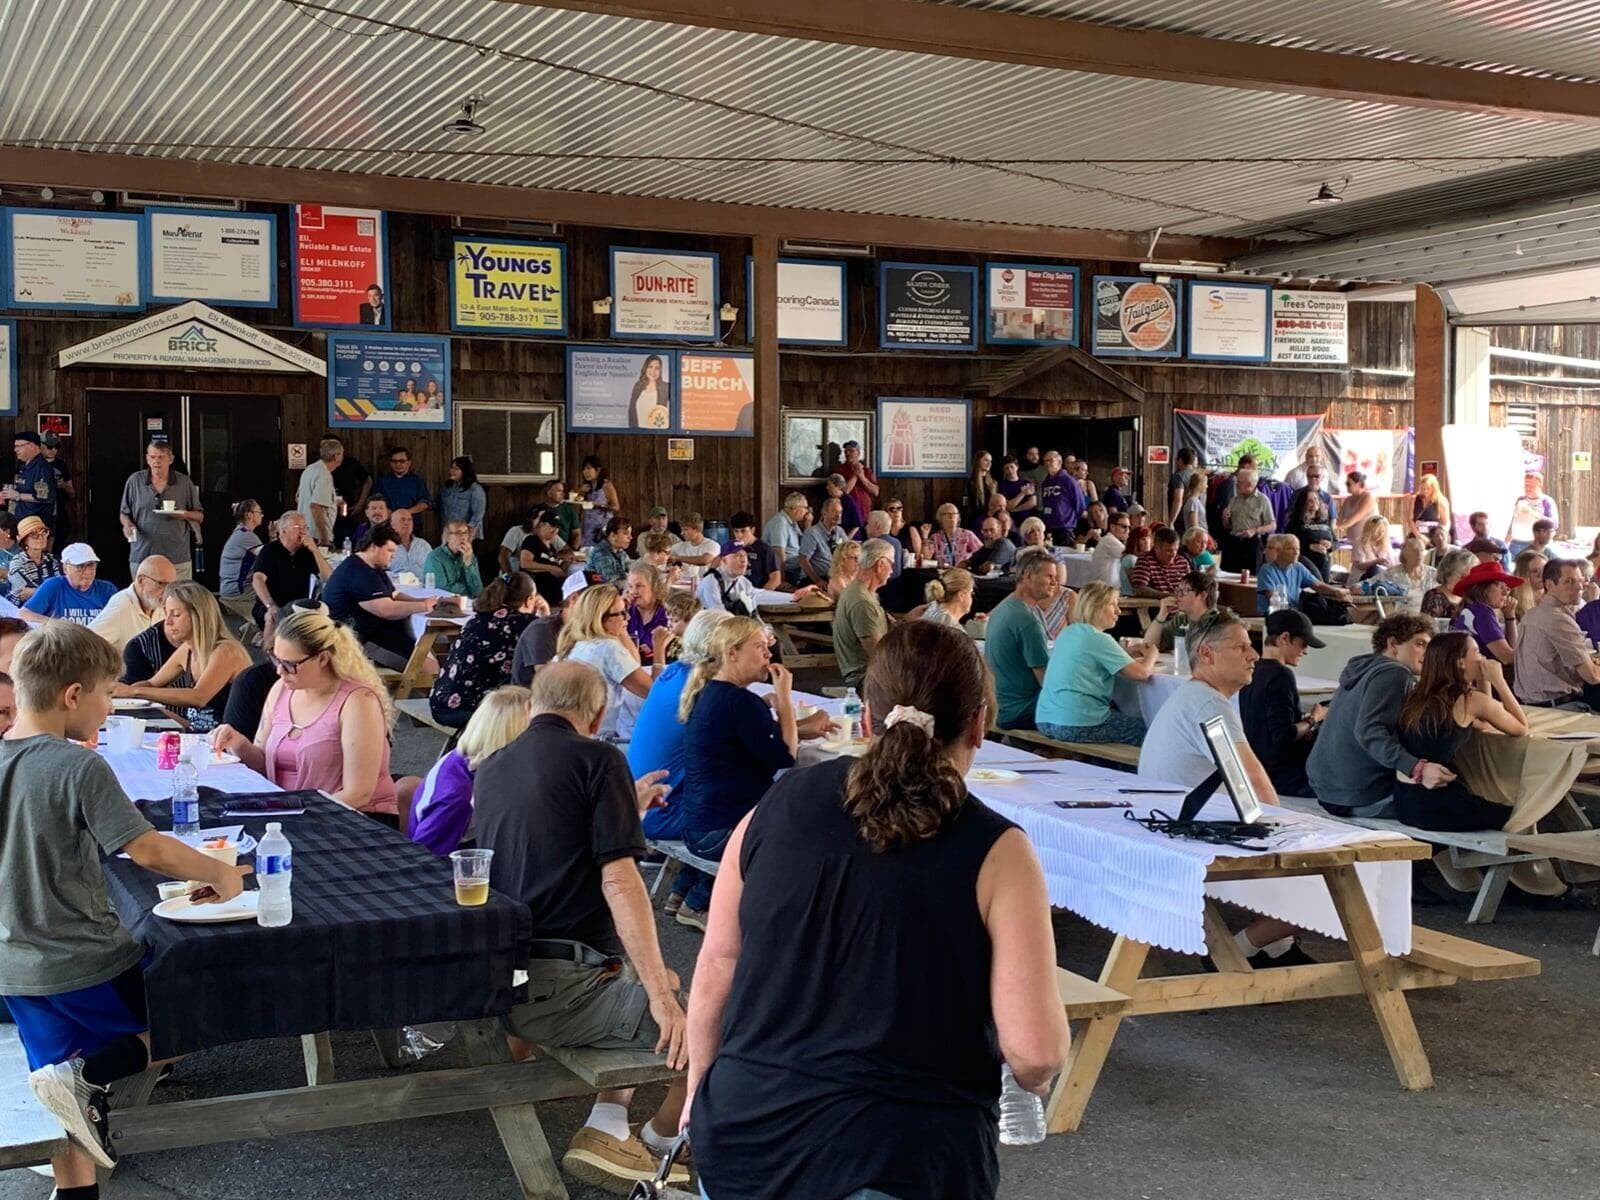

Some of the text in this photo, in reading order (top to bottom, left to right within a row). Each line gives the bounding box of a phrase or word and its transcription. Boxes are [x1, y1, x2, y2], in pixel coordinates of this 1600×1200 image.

[299, 242, 329, 250] Reliable
[349, 245, 372, 253] Estate
[300, 258, 366, 268] ELI MILENKOFF
[1042, 271, 1055, 280] City
[300, 279, 354, 288] 905.380.3111
[636, 276, 695, 294] DUN-RITE
[777, 295, 840, 307] ooringCanada
[1283, 300, 1345, 311] Trees Company
[492, 304, 510, 312] Main
[479, 312, 539, 322] 905-788-3171
[208, 312, 218, 321] Eli
[220, 318, 258, 339] Milenkoff
[65, 312, 179, 360] www.brickproperties.ca
[113, 352, 153, 361] PROPERTY
[159, 354, 186, 362] RENTAL
[187, 356, 236, 364] MANAGEMENT
[238, 358, 271, 366] SERVICES
[575, 356, 600, 364] Seeking
[681, 358, 722, 374] JEFF
[575, 370, 600, 378] English
[681, 375, 744, 392] BURCH
[64, 608, 68, 617] I
[68, 608, 88, 617] WILL
